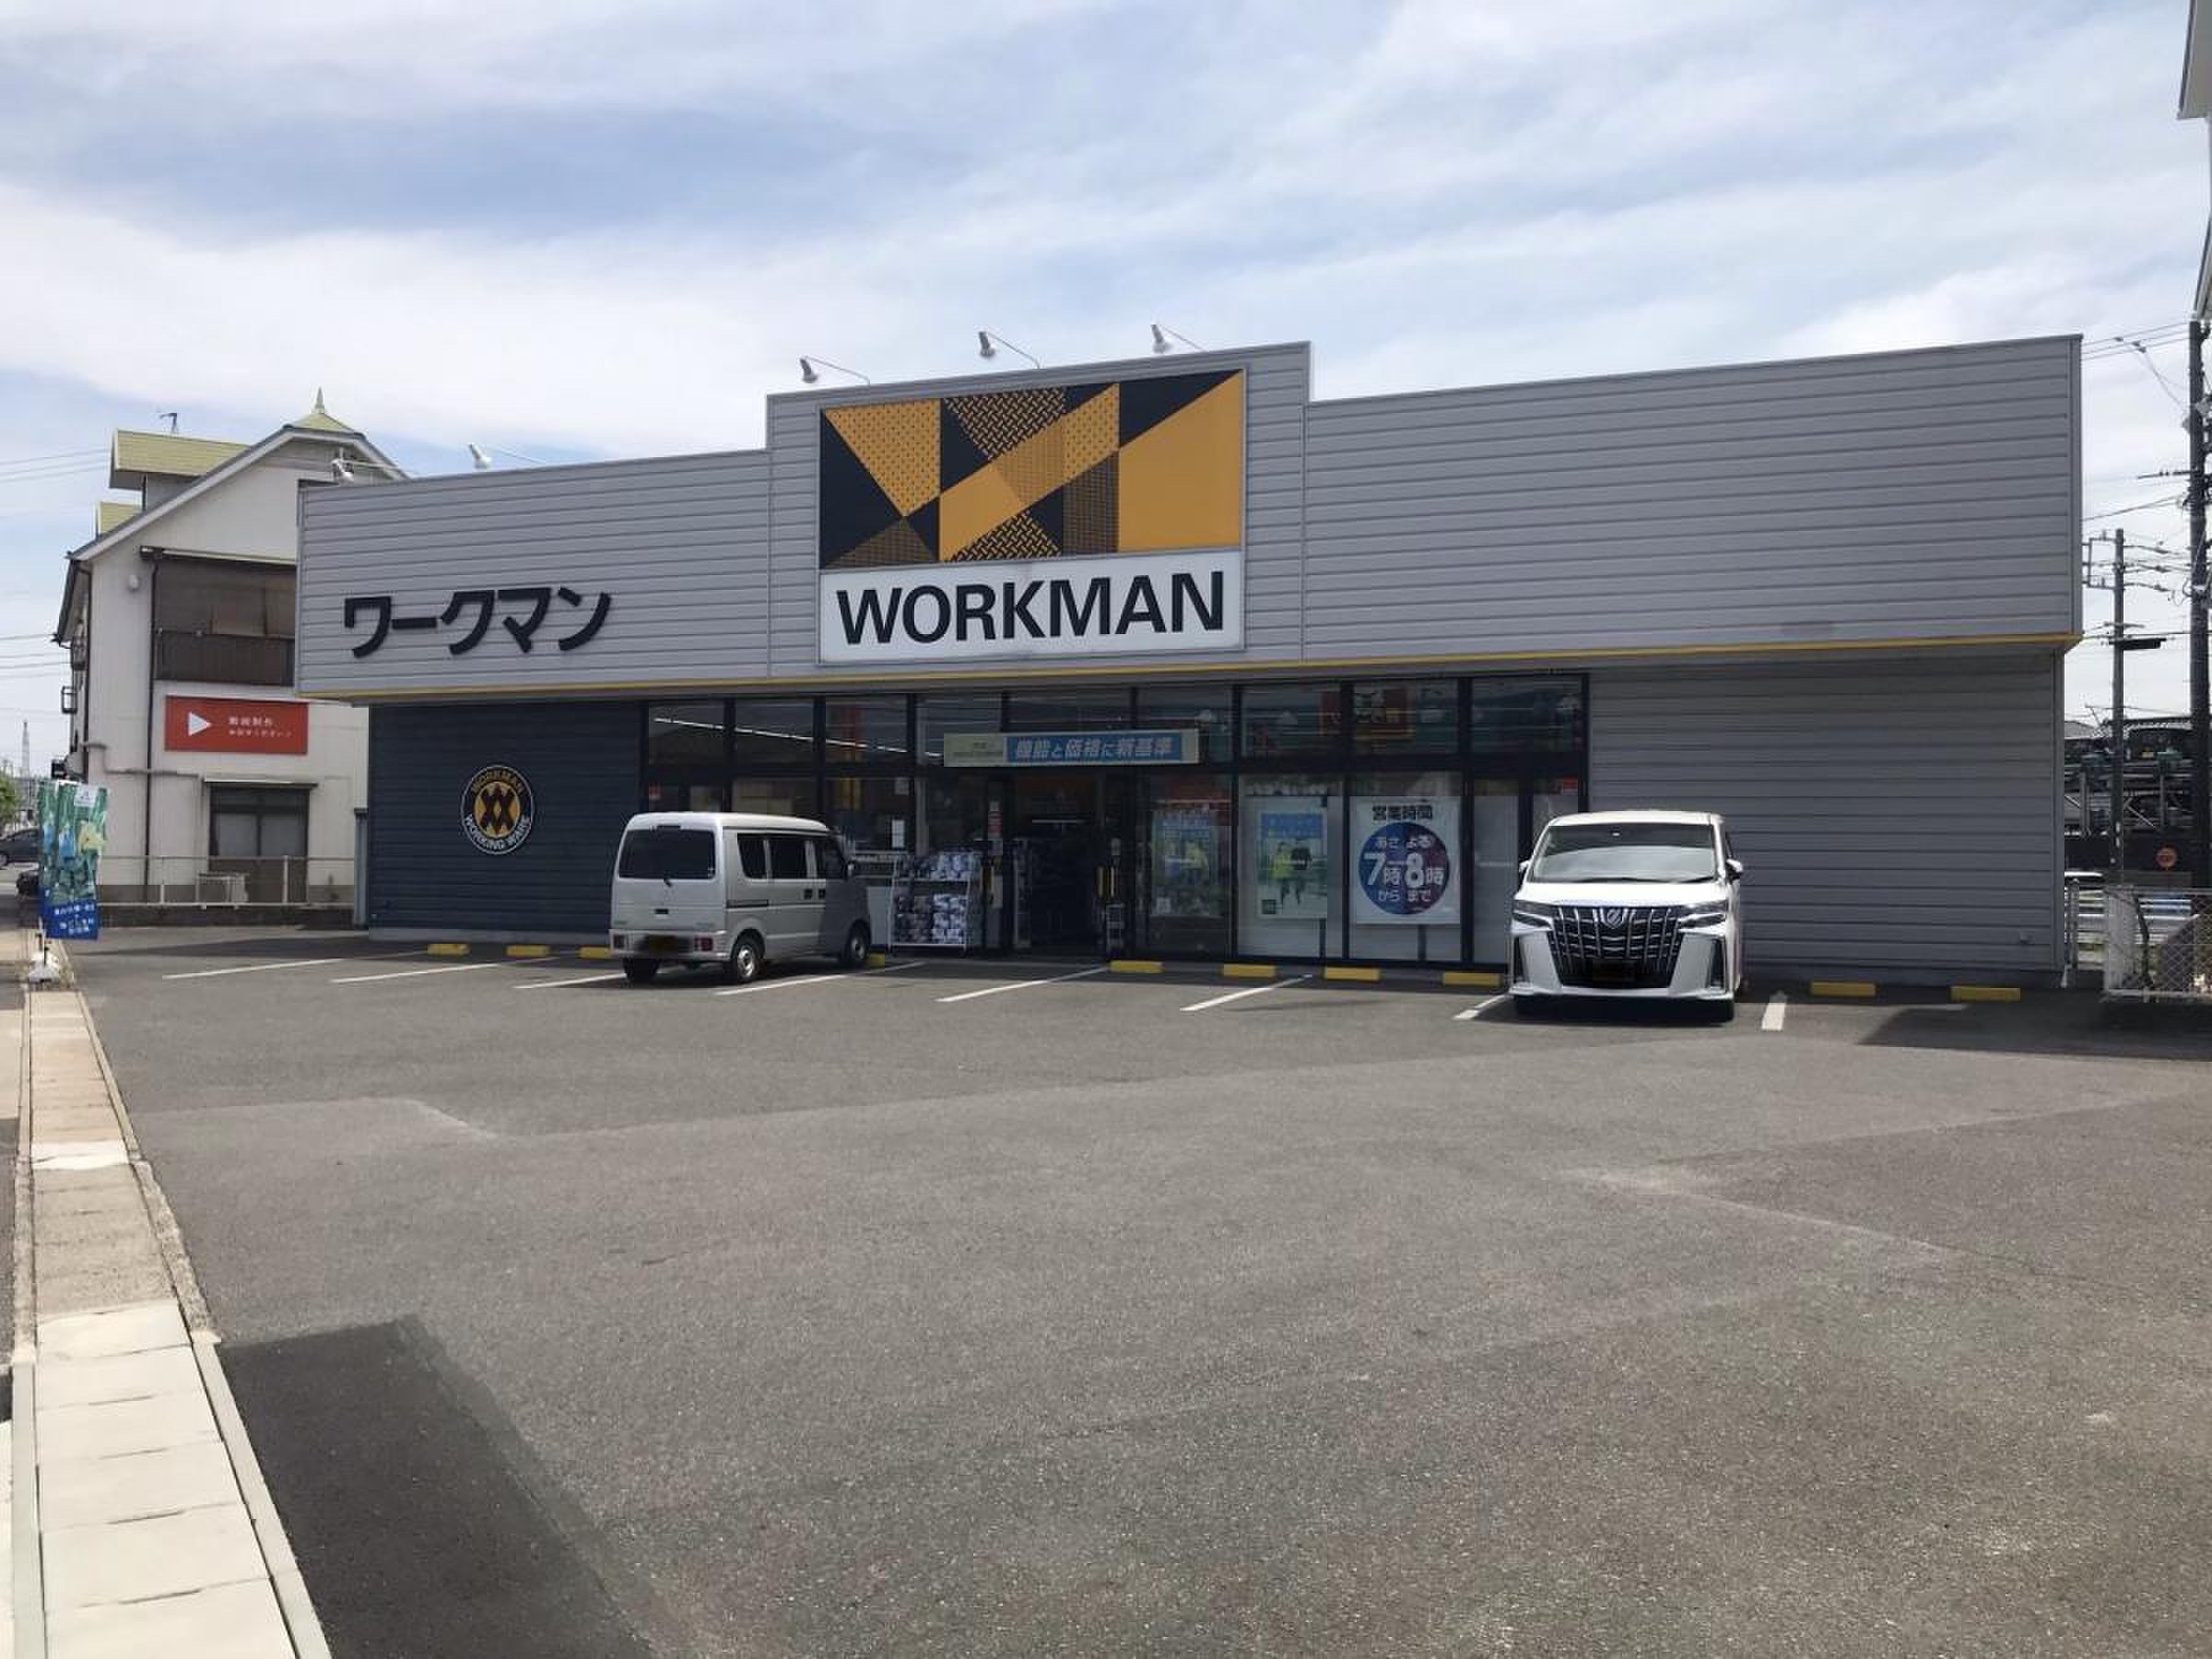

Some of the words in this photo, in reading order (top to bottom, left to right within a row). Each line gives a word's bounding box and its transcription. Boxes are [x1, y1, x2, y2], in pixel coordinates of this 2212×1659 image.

[837, 570, 1225, 645] WORKMAN
[344, 586, 612, 658] ワークマン
[1372, 805, 1433, 820] 営業時間
[1375, 836, 1400, 849] あさ
[1406, 834, 1431, 849] よる
[1363, 852, 1402, 886] 7時
[1405, 853, 1445, 888] 8時
[1378, 889, 1401, 902] から
[1406, 889, 1431, 902] まで
